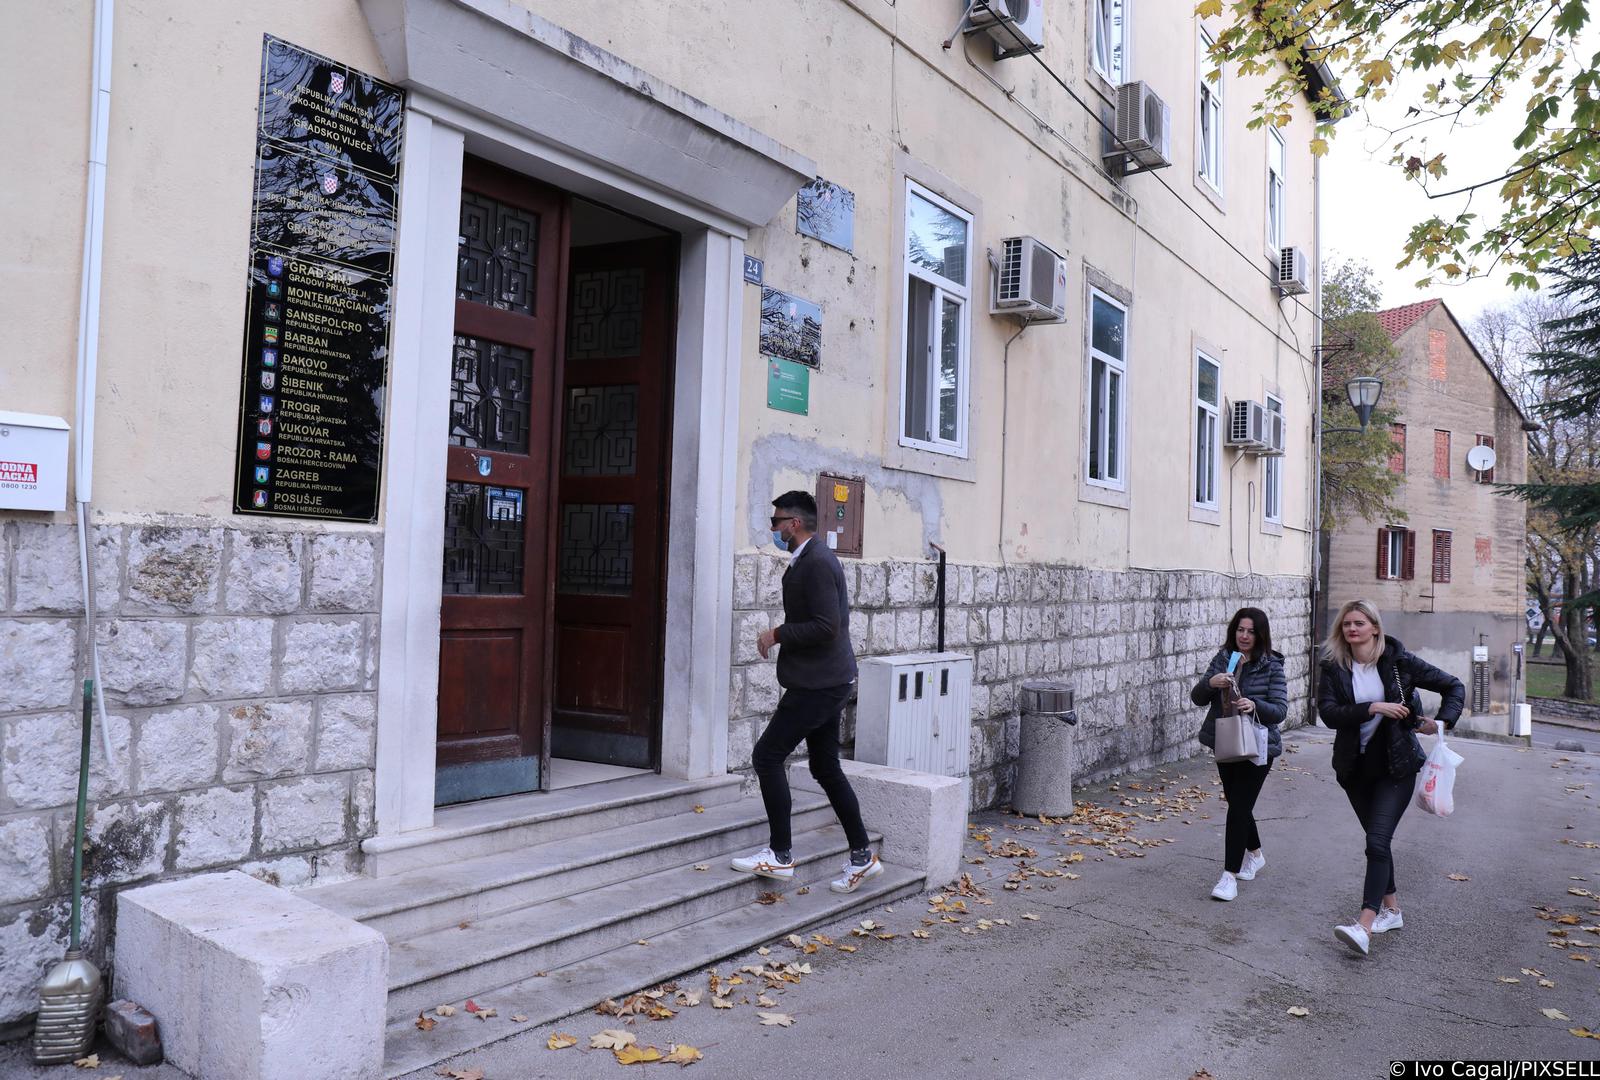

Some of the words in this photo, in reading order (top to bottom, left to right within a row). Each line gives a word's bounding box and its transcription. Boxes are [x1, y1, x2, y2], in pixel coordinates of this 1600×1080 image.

[272, 88, 359, 125] SPLITSKO-DALMATINSKA
[296, 84, 336, 106] REPUBLIKA
[340, 102, 374, 120] HRVATSKA
[314, 116, 338, 129] GRAD
[339, 125, 357, 136] SINJ
[293, 119, 340, 141] GRADSKO
[341, 134, 373, 153] VIJEĆE
[325, 142, 342, 153] SINJ
[289, 187, 330, 206] REPUBLIKA
[289, 262, 323, 278] GRAD
[326, 271, 353, 285] SINJ
[747, 260, 758, 274] 24
[289, 273, 324, 288] GRADOVI
[326, 283, 367, 298] PRIJATELJI
[287, 286, 376, 315] MONTEMARCIANO
[287, 297, 322, 309] REPUBLIKA
[323, 304, 344, 314] ITALIJA
[285, 319, 320, 332] REPUBLIKA
[322, 328, 343, 336] ITALIJA
[286, 308, 362, 333] SANSEPOLCRO
[284, 331, 328, 348] BARBAN
[284, 342, 319, 354] REPUBLIKA
[320, 349, 351, 360] HRVATSKA
[283, 353, 328, 370] ĐAKOVO
[283, 364, 318, 376] REPUBLIKA
[318, 372, 350, 382] HRVATSKA
[282, 375, 323, 392] ŠIBENIK
[281, 387, 316, 398] REPUBLIKA
[317, 393, 348, 403] HRVATSKA
[281, 399, 321, 414] TROGIR
[280, 410, 315, 421] REPUBLIKA
[316, 416, 347, 425] HRVATSKA
[279, 422, 330, 437] VUKOVAR
[279, 433, 314, 443] REPUBLIKA
[314, 438, 345, 447] HRVATSKA
[277, 445, 321, 459] PROZOR
[329, 452, 357, 463] RAMA
[0, 463, 33, 472] ODNA
[277, 457, 299, 465] BOSNA
[303, 460, 346, 470] HERCEGOVINA
[0, 471, 35, 482] ACIJA
[276, 469, 319, 482] ZAGREB
[275, 481, 311, 489] REPUBLIKA
[311, 484, 342, 492] HRVATSKA
[274, 492, 322, 506] POSUŠJE
[300, 506, 343, 515] HERCEGOVINA
